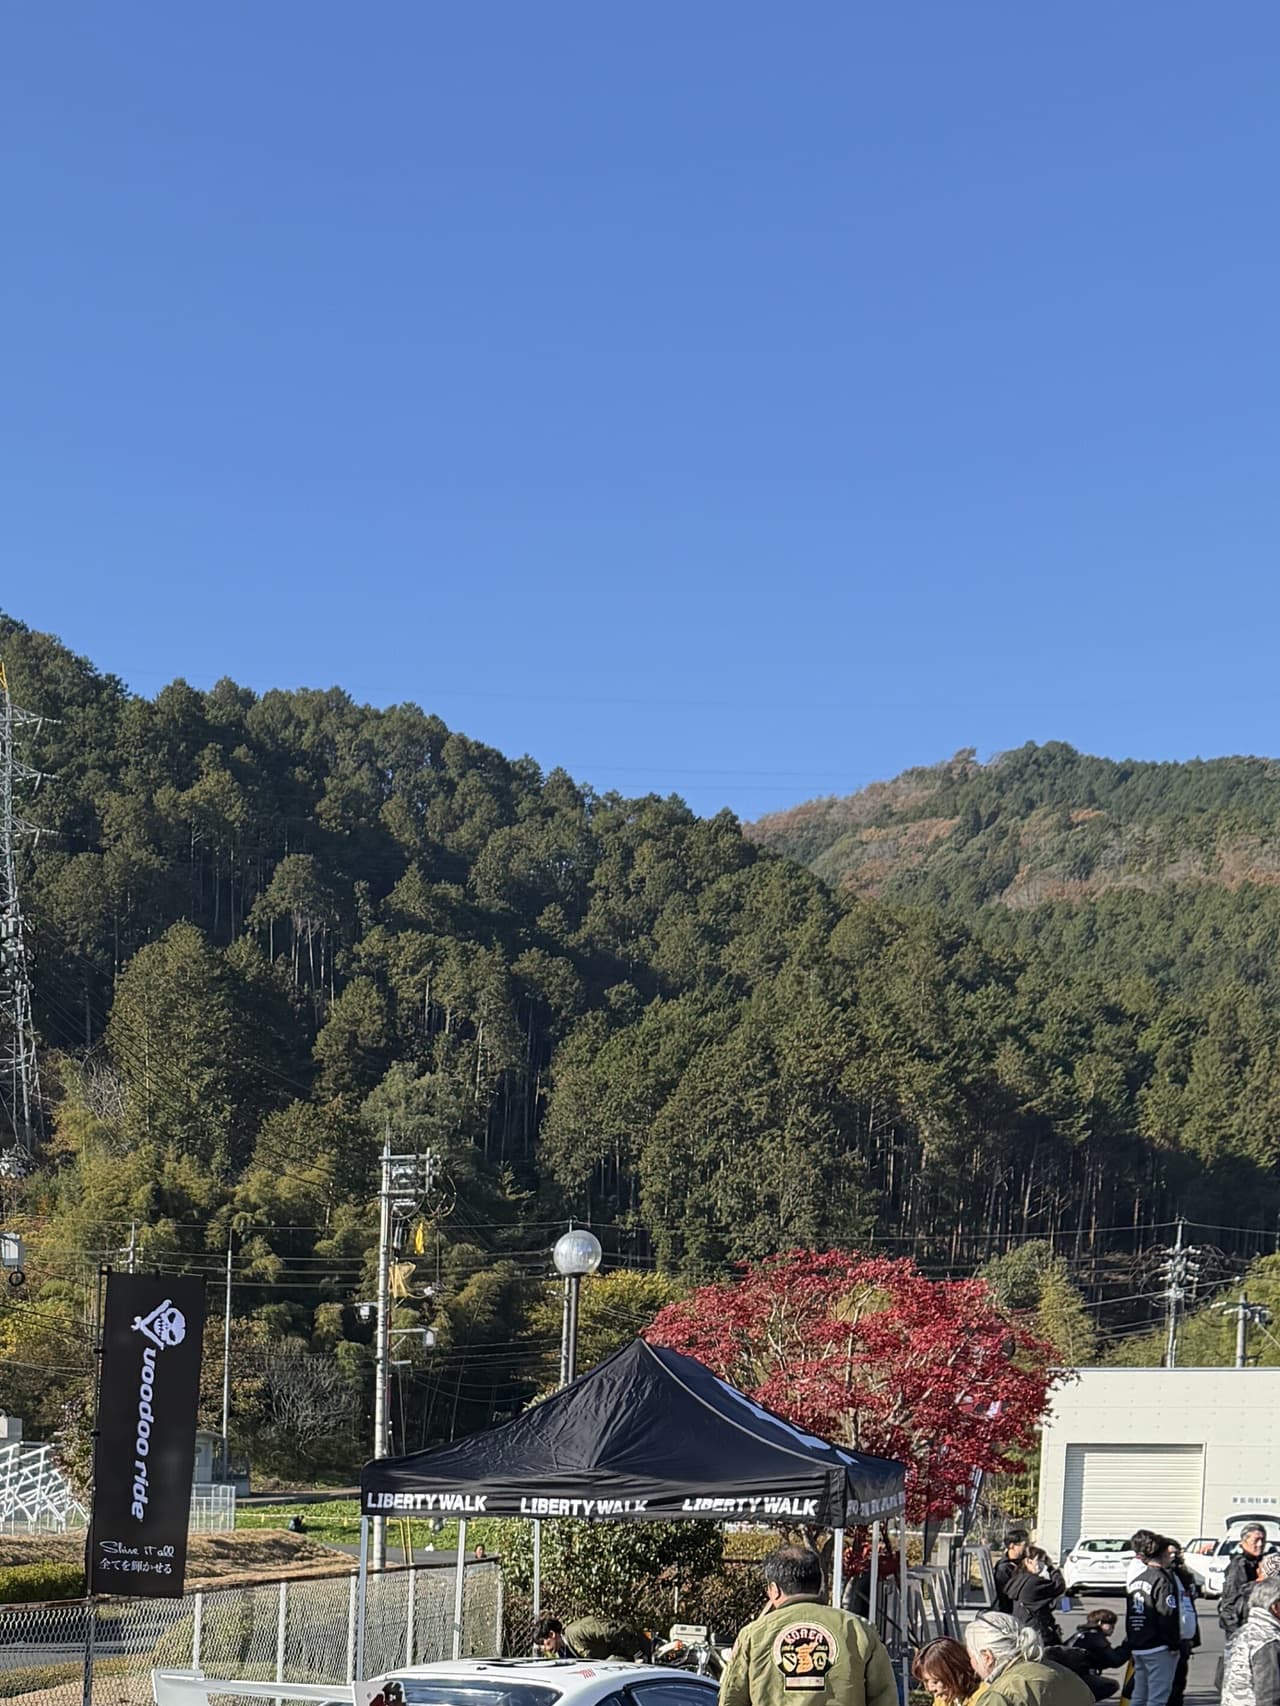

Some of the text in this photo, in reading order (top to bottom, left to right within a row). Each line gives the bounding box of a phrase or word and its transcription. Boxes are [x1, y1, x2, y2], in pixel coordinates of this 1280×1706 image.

[131, 1459, 150, 1522] ride
[367, 1492, 487, 1512] LIBERTY WALK
[521, 1496, 650, 1516] LIBERTY WALK
[682, 1496, 819, 1517] LIBERTY WALK
[784, 1629, 825, 1645] KOREA
